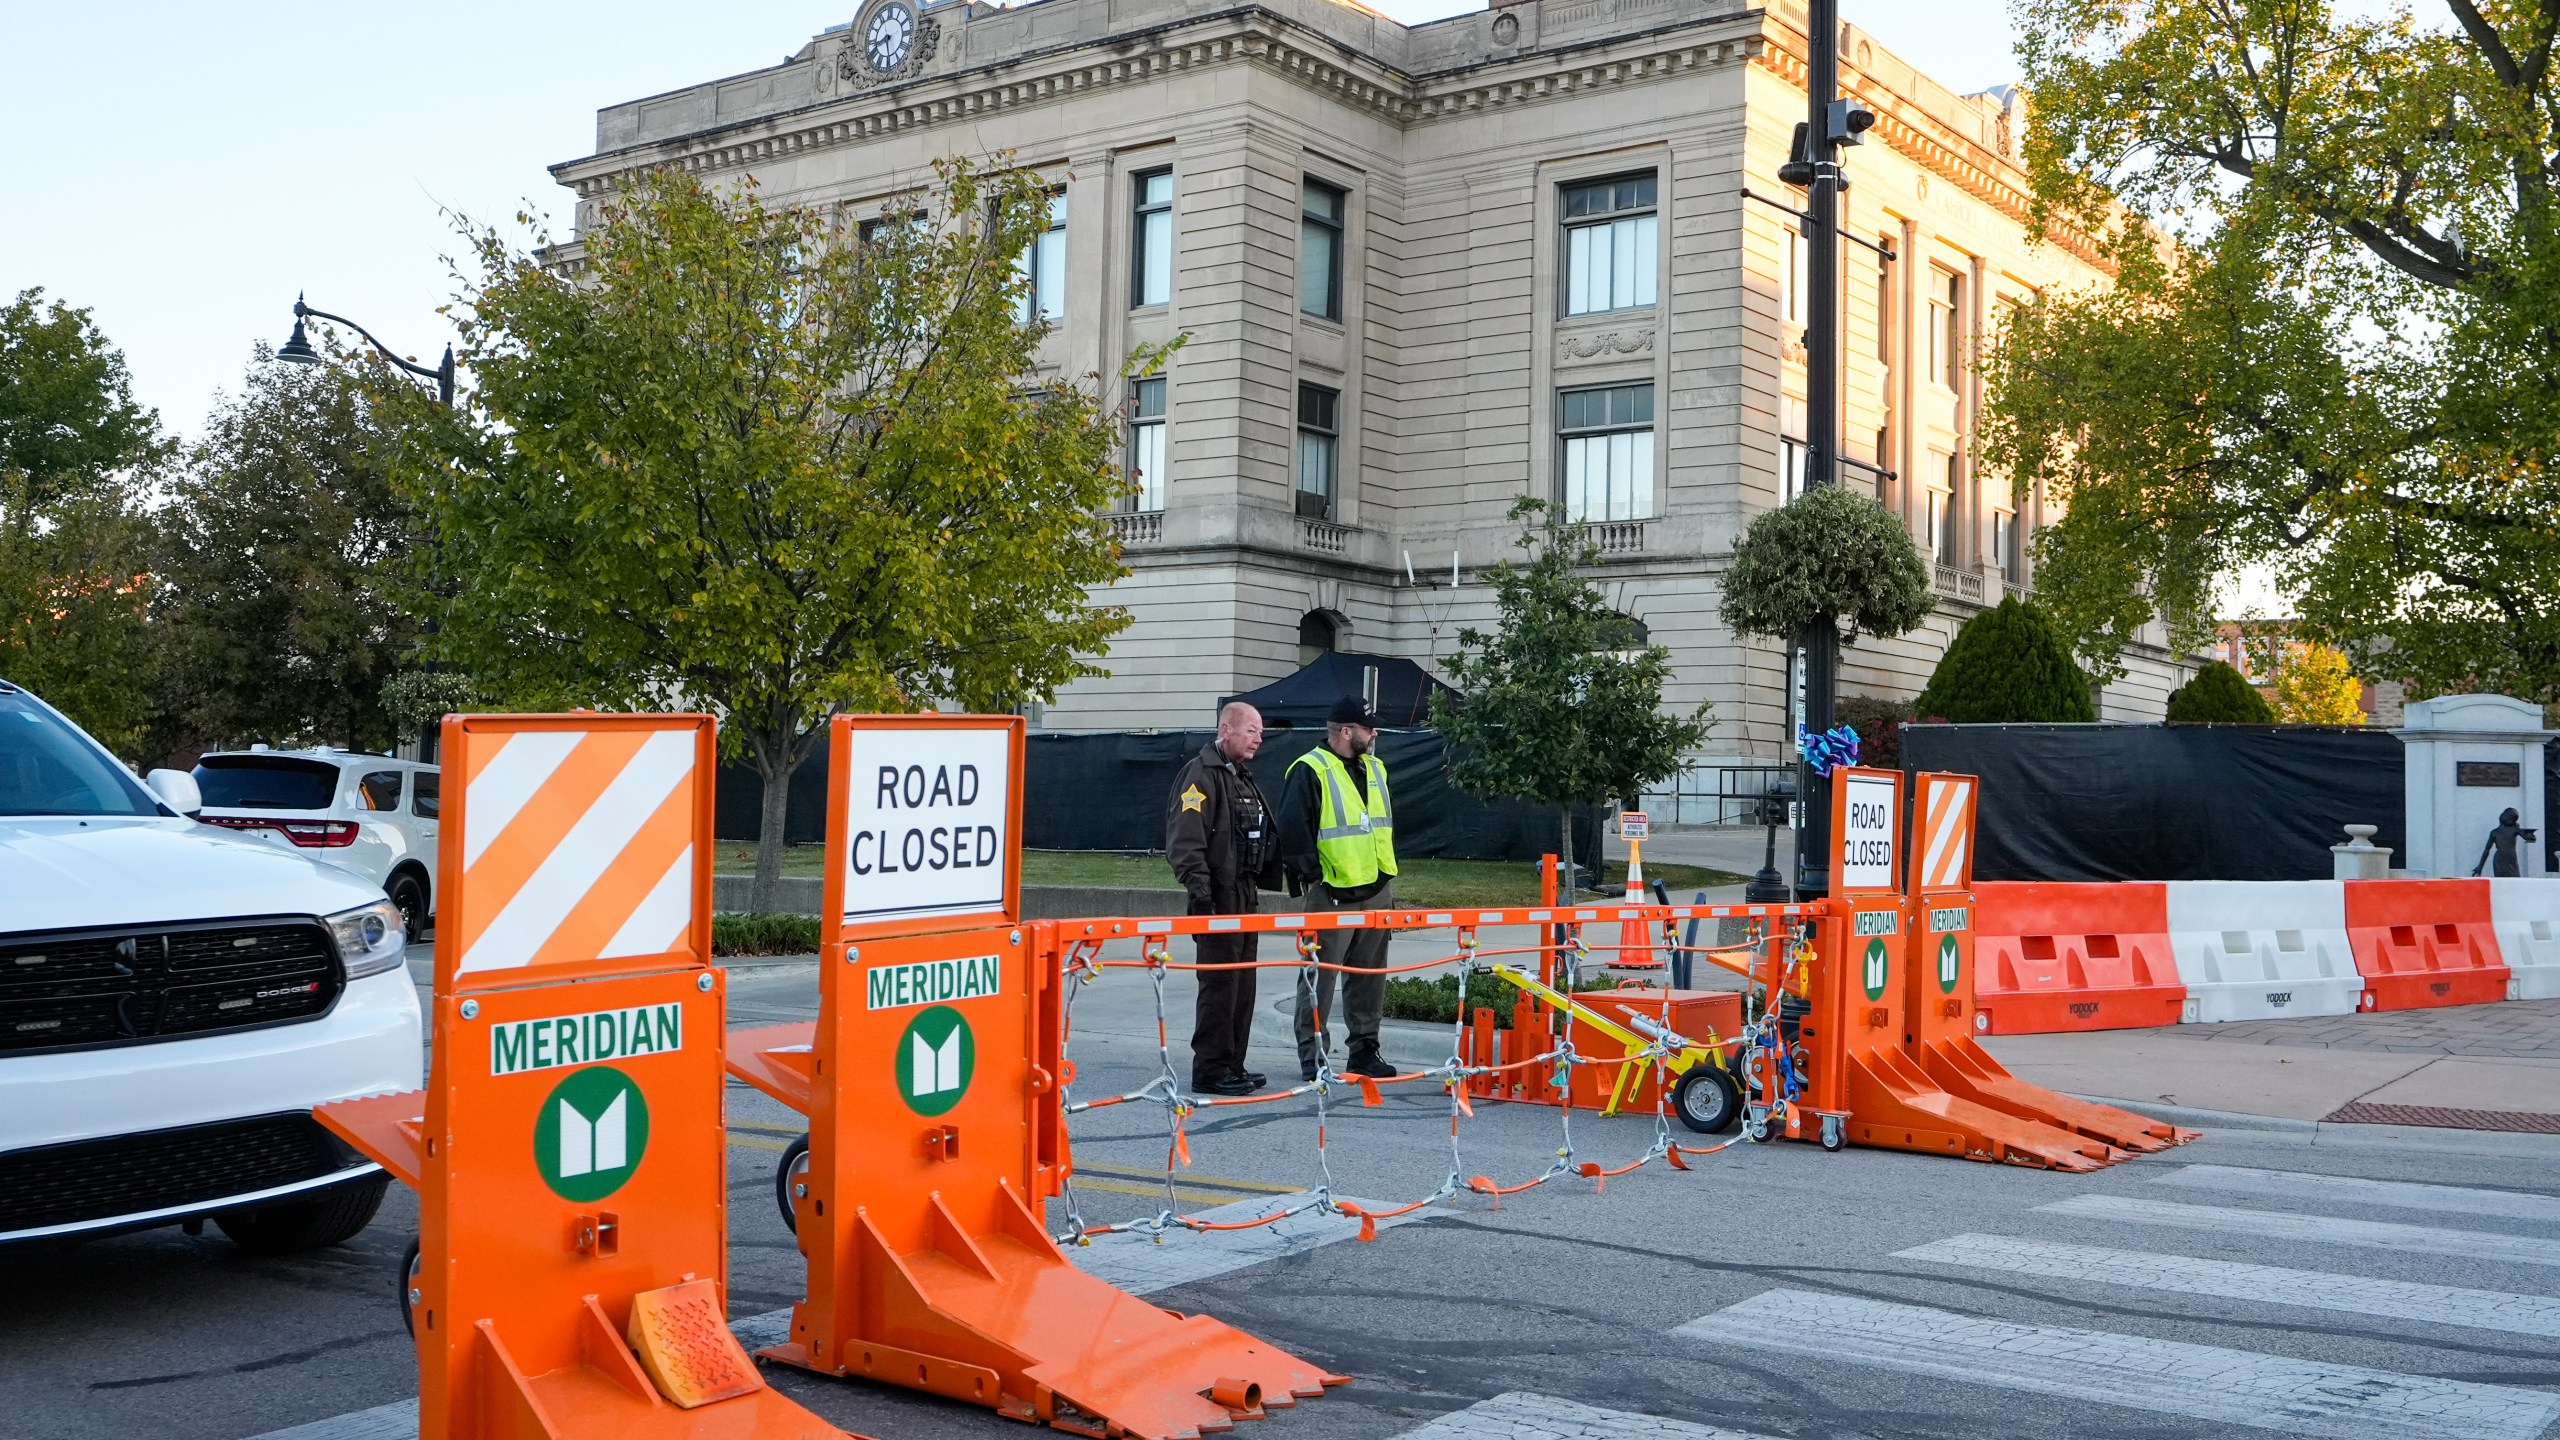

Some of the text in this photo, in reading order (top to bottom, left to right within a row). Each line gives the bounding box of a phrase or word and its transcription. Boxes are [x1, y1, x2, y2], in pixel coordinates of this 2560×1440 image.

[877, 764, 979, 810] ROAD
[1851, 802, 1886, 830] ROAD
[851, 825, 997, 876] CLOSED
[1843, 839, 1891, 866] CLOSED
[1855, 912, 1897, 935] MERIDIAN
[1931, 908, 1967, 932] MERIDIAN
[256, 985, 312, 998] DODGE
[869, 957, 998, 1009] MERIDIAN
[494, 1004, 679, 1074] MERIDIAN
